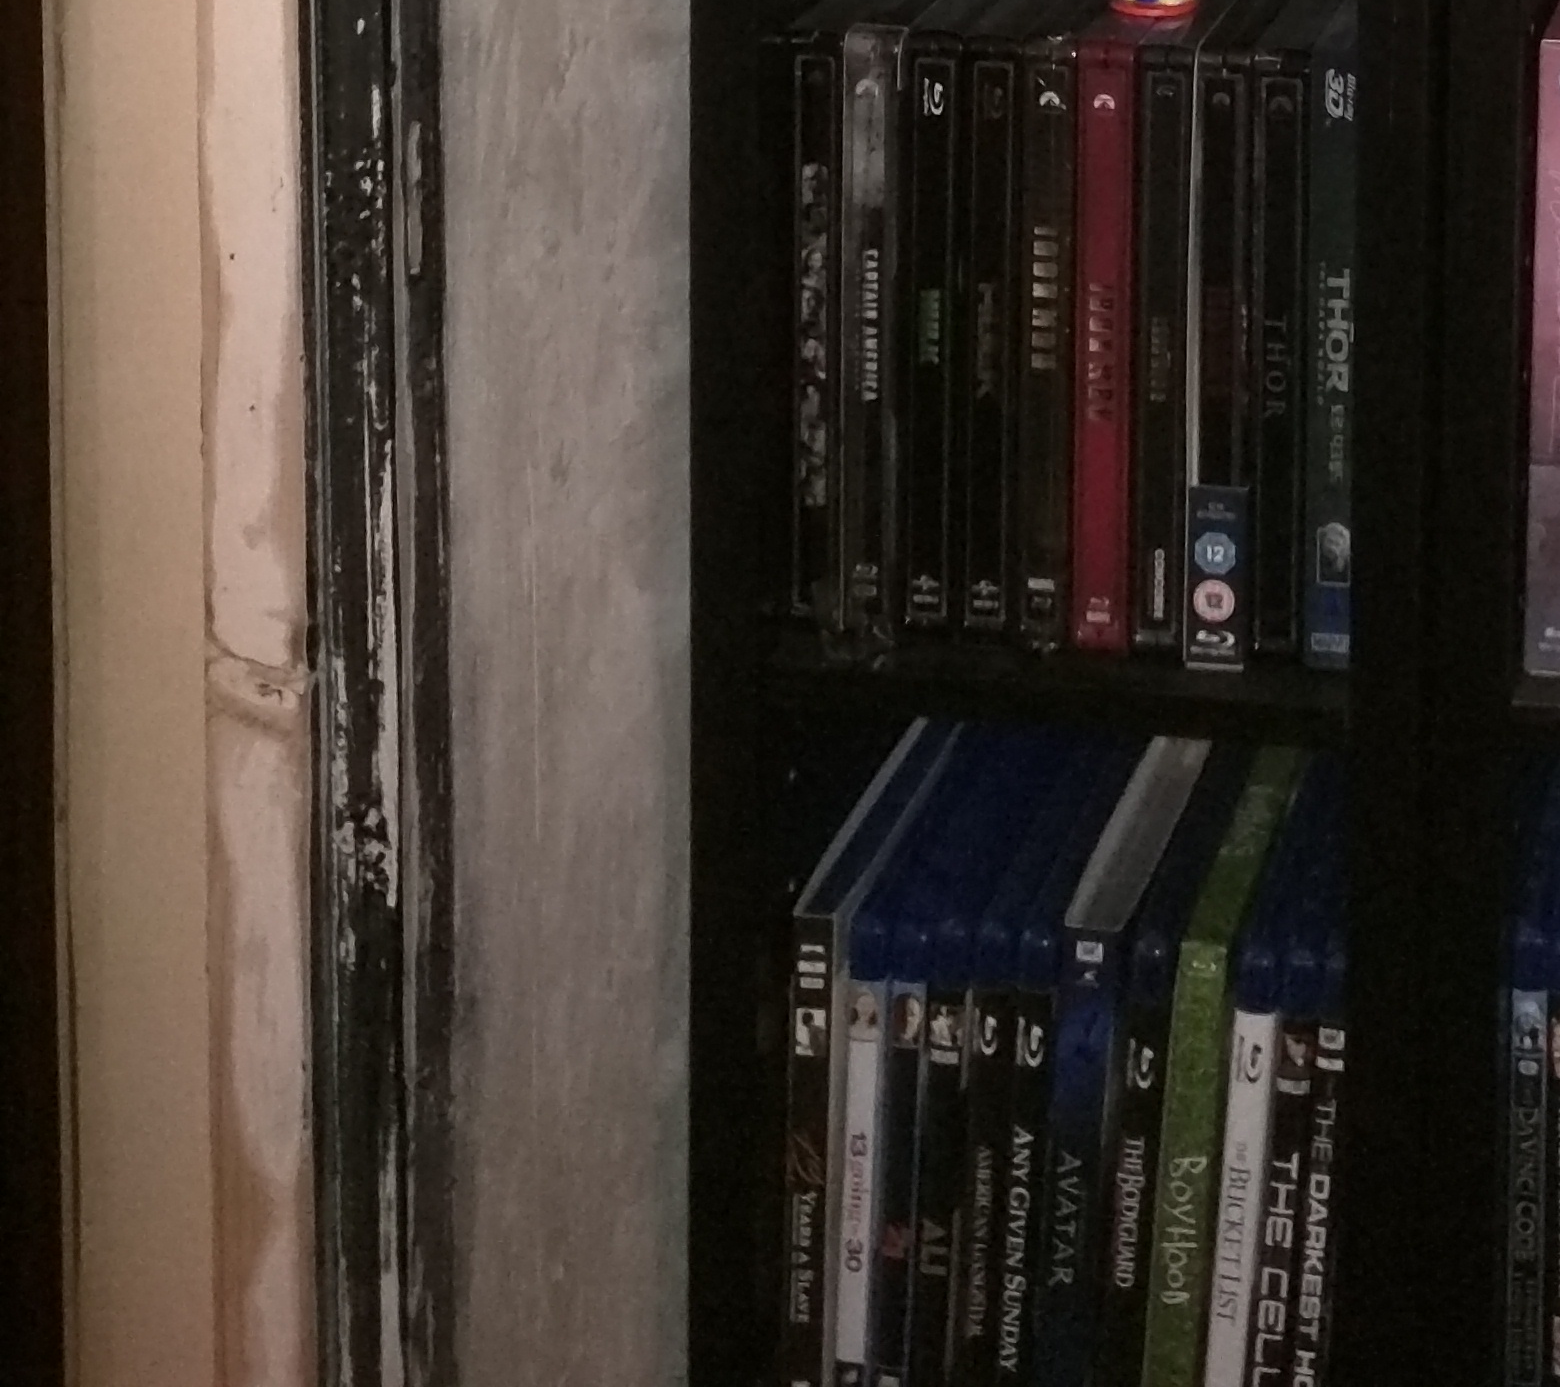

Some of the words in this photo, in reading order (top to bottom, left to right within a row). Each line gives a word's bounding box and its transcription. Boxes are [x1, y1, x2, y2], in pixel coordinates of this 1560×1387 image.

[1325, 67, 1344, 120] 3D
[1266, 315, 1288, 418] THOR
[1325, 267, 1354, 393] THOR
[1206, 545, 1223, 562] 12
[852, 1132, 867, 1157] 13
[1010, 1124, 1035, 1183] ANY
[1123, 1135, 1146, 1172] THE
[1310, 1099, 1338, 1164] THE
[797, 1190, 819, 1248] YEARS
[1004, 1185, 1031, 1272] GIVEN
[1049, 1149, 1083, 1287] AVATAR
[1114, 1172, 1146, 1288] BODYGUARD
[1221, 1166, 1250, 1265] BUCKET
[1264, 1151, 1300, 1249] THE
[844, 1237, 863, 1273] 30
[1298, 1173, 1332, 1342] DARKEST
[796, 1268, 815, 1324] SLAVE
[999, 1273, 1028, 1374] SUNDAY
[1215, 1273, 1242, 1323] LIST
[1251, 1266, 1290, 1387] CELL
